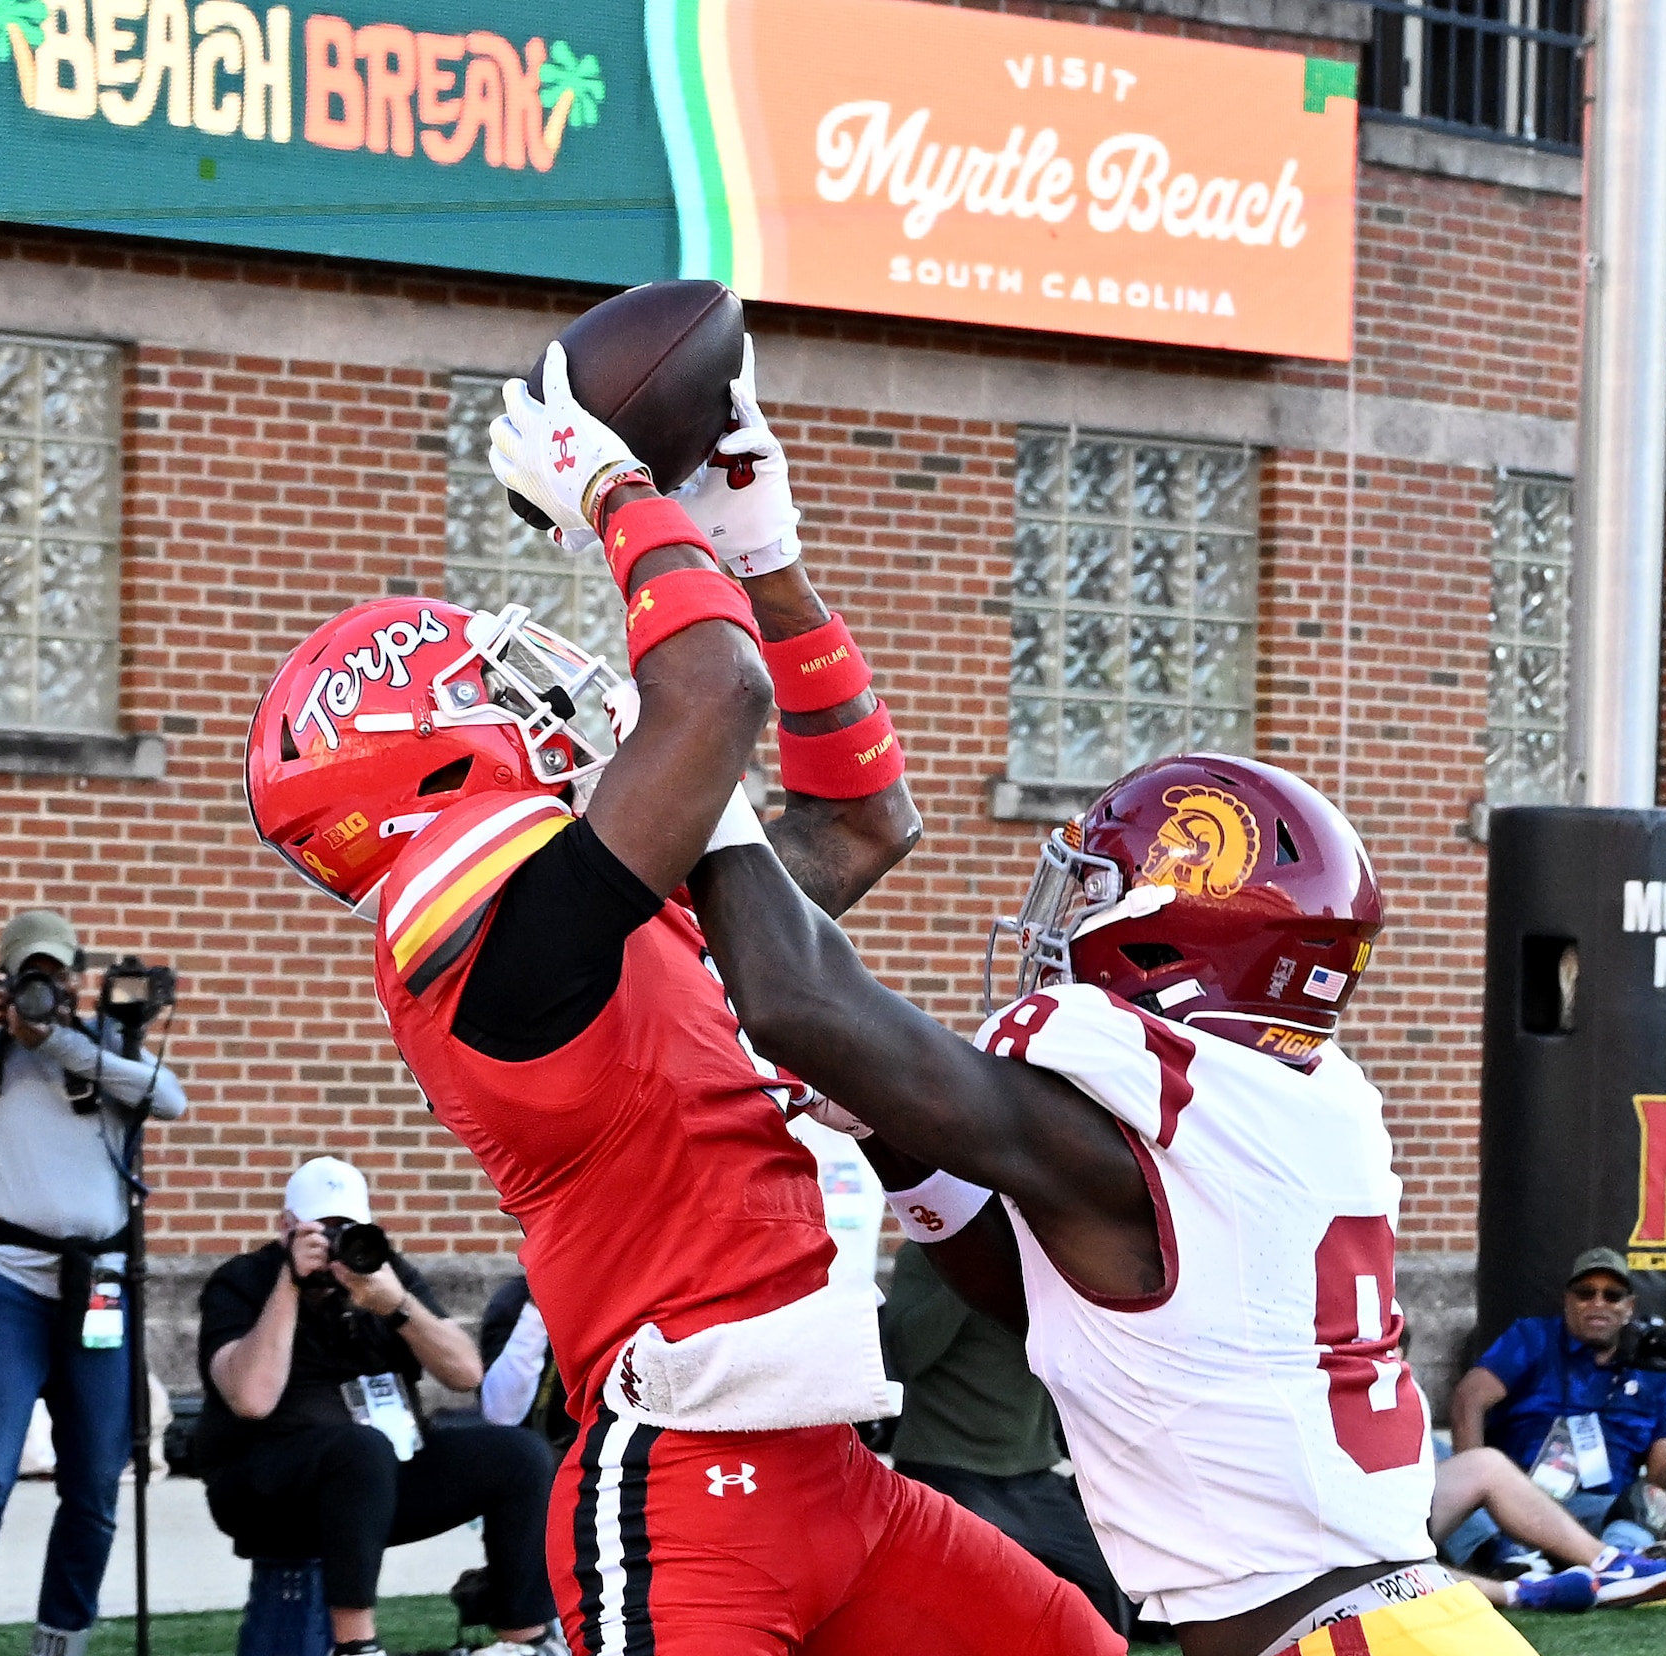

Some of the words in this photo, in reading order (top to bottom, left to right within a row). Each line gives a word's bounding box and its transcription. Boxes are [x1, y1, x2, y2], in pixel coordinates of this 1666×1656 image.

[31, 0, 291, 143] BEACH
[304, 14, 547, 172] BREAK
[1005, 54, 1137, 101] VISIT
[816, 100, 1076, 239] Myrtle
[1085, 132, 1307, 248] Beach
[888, 256, 1023, 293] SOUTH
[1041, 272, 1236, 317] CAROLINA
[294, 608, 450, 751] Terps
[800, 644, 850, 676] MARYLAND
[985, 993, 1060, 1062] 8
[1313, 1213, 1426, 1475] 8
